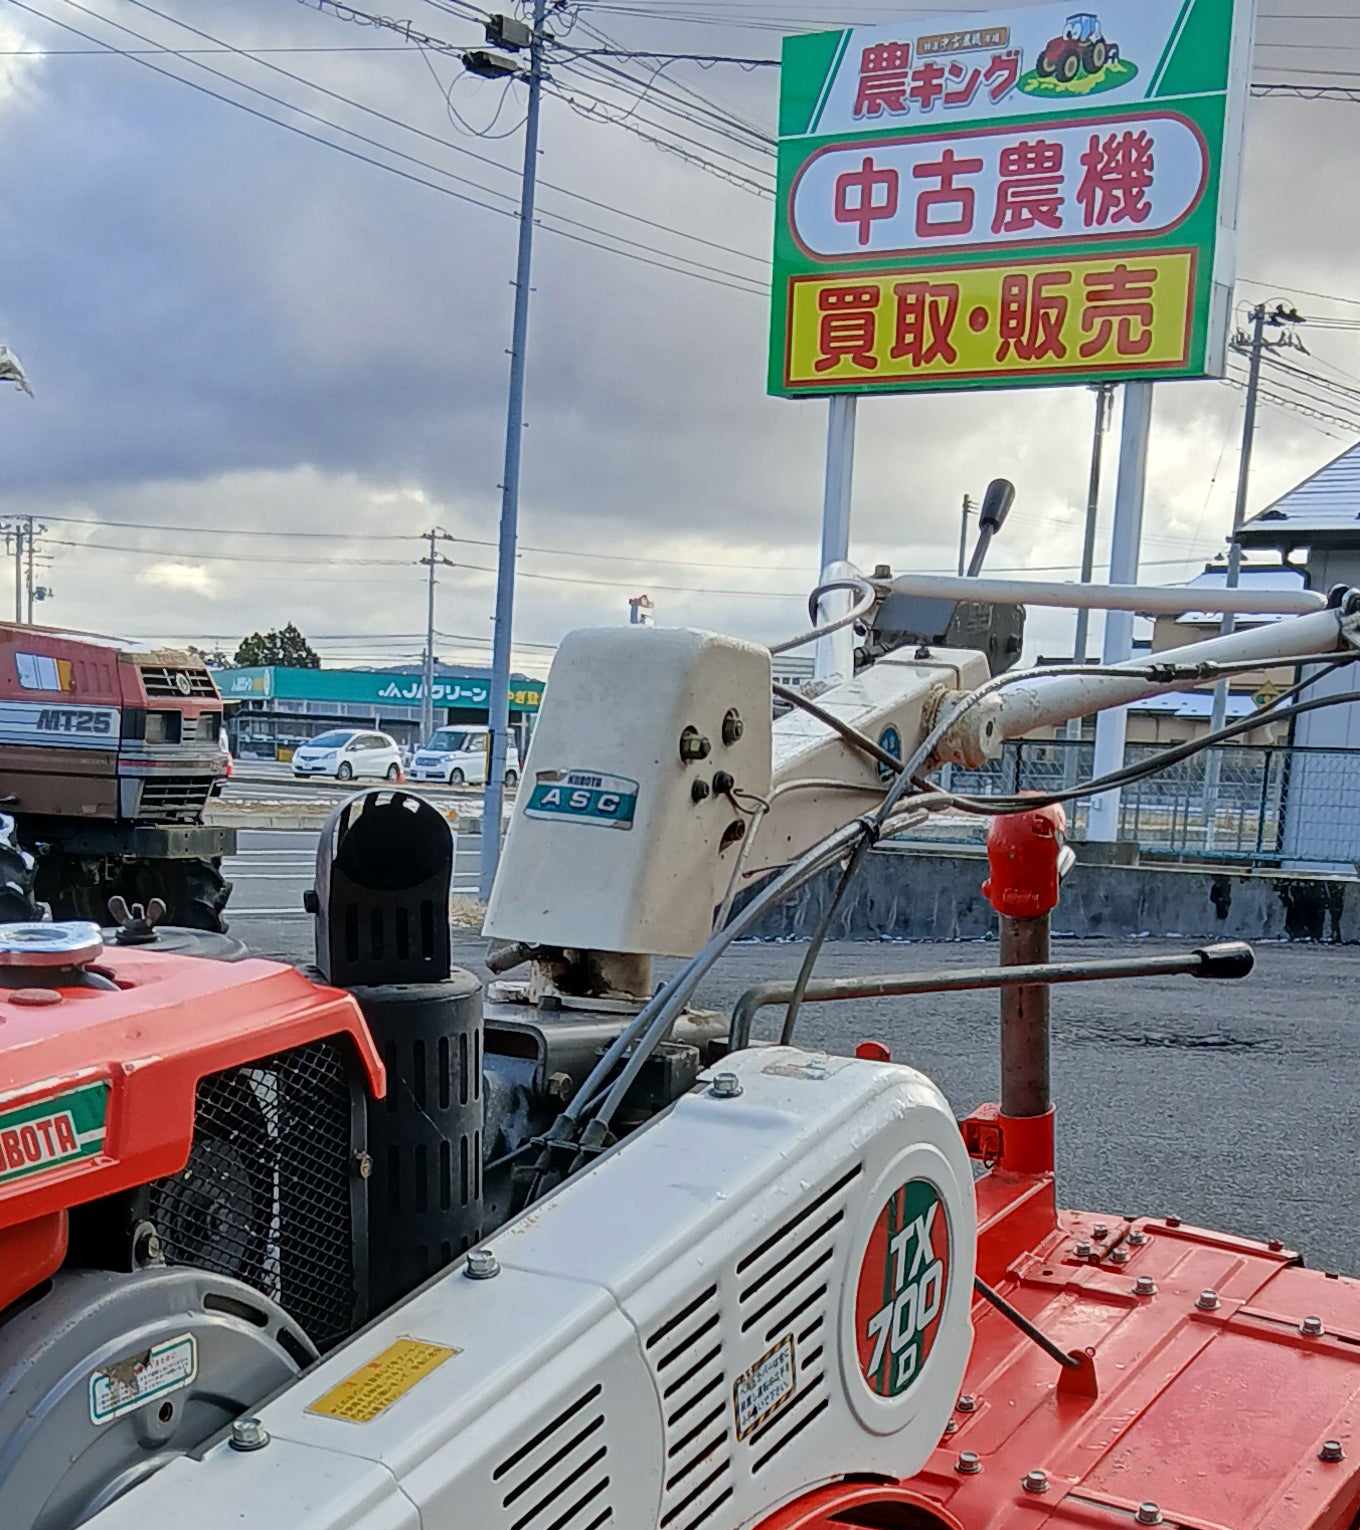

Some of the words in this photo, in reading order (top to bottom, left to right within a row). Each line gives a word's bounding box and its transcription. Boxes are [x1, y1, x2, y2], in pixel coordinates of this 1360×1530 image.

[853, 41, 1022, 118] 農キング
[833, 129, 1156, 247] 中古農機
[814, 264, 1158, 373] 買取・販売
[37, 709, 111, 734] MT25
[567, 774, 602, 788] KUBOTA
[890, 1200, 939, 1293] TX
[866, 1259, 944, 1379] 700
[895, 1342, 918, 1389] D
